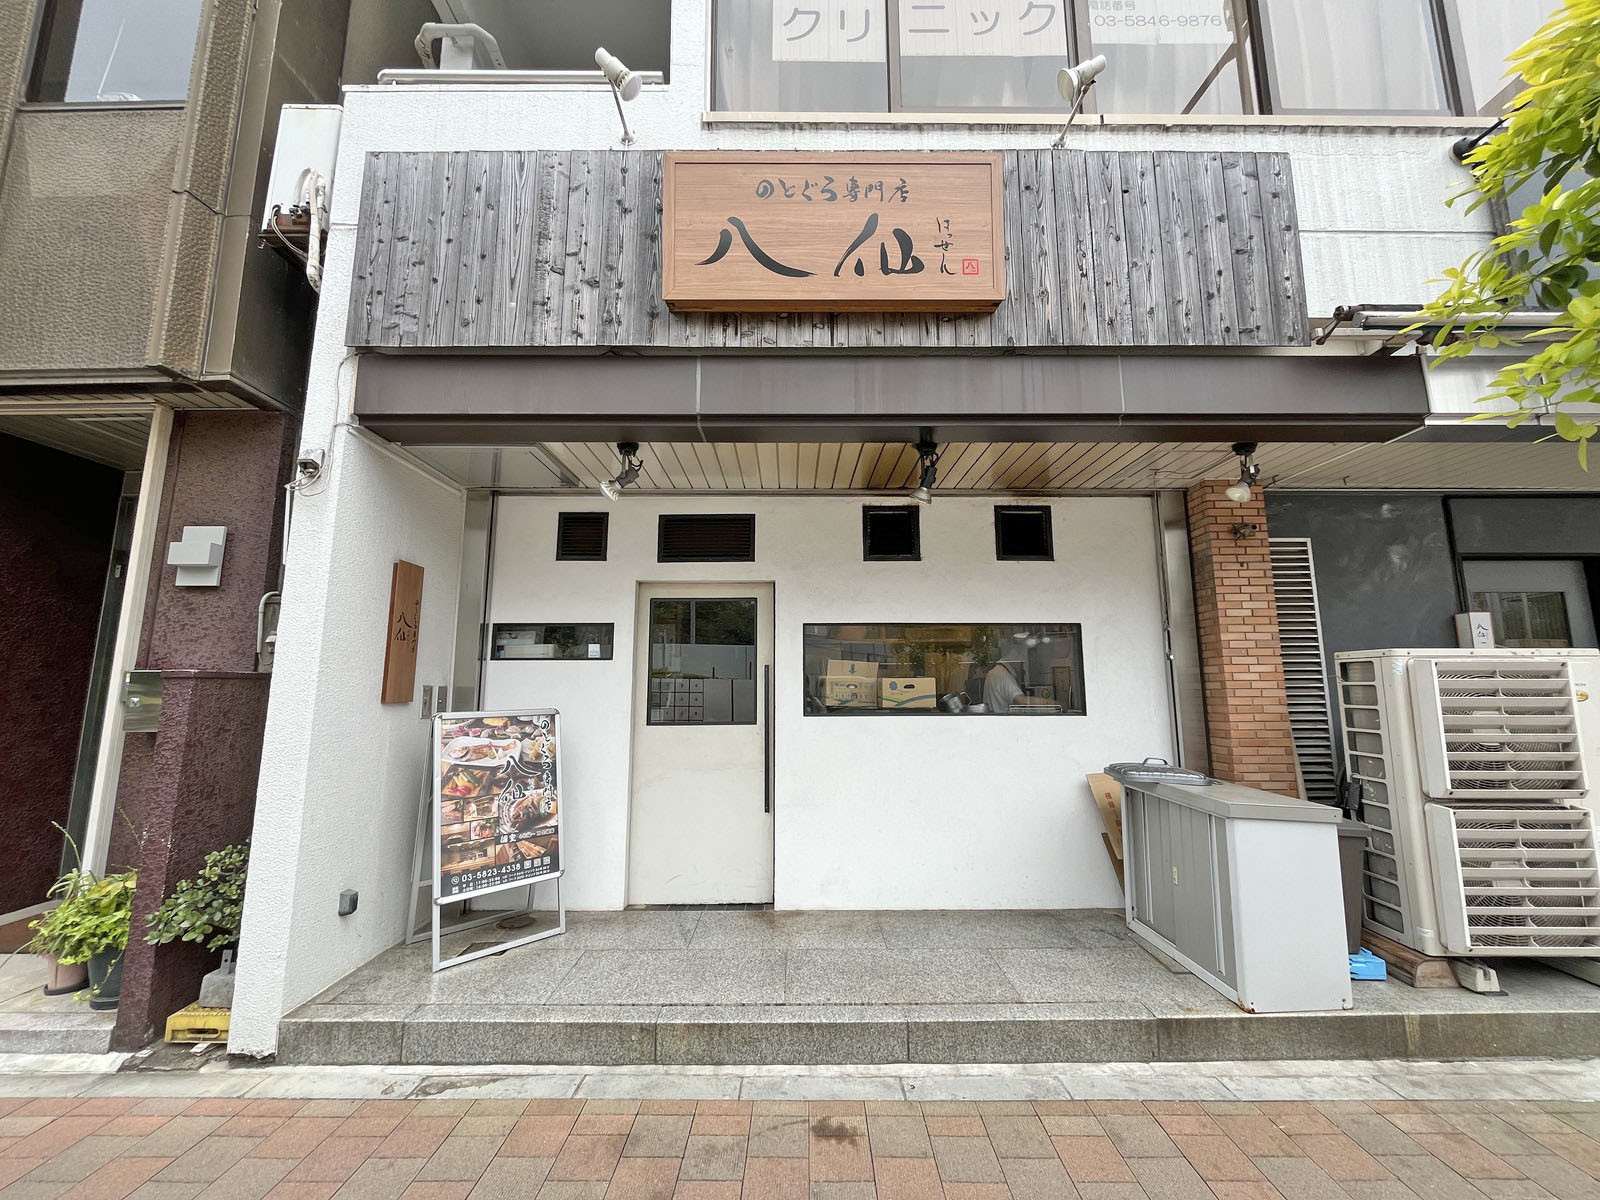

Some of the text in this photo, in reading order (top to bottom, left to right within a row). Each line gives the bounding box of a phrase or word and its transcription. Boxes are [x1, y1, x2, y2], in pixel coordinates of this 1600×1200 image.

[783, 1, 1056, 43] クリニック
[1094, 15, 1222, 27] 03-5846-9876
[755, 175, 910, 203] のどぐろ専門店
[694, 212, 925, 278] 八仙
[933, 216, 957, 275] はっせん
[394, 611, 413, 641] 八仙
[498, 755, 541, 803] 八仙
[462, 864, 521, 882] 03-5823-4338
